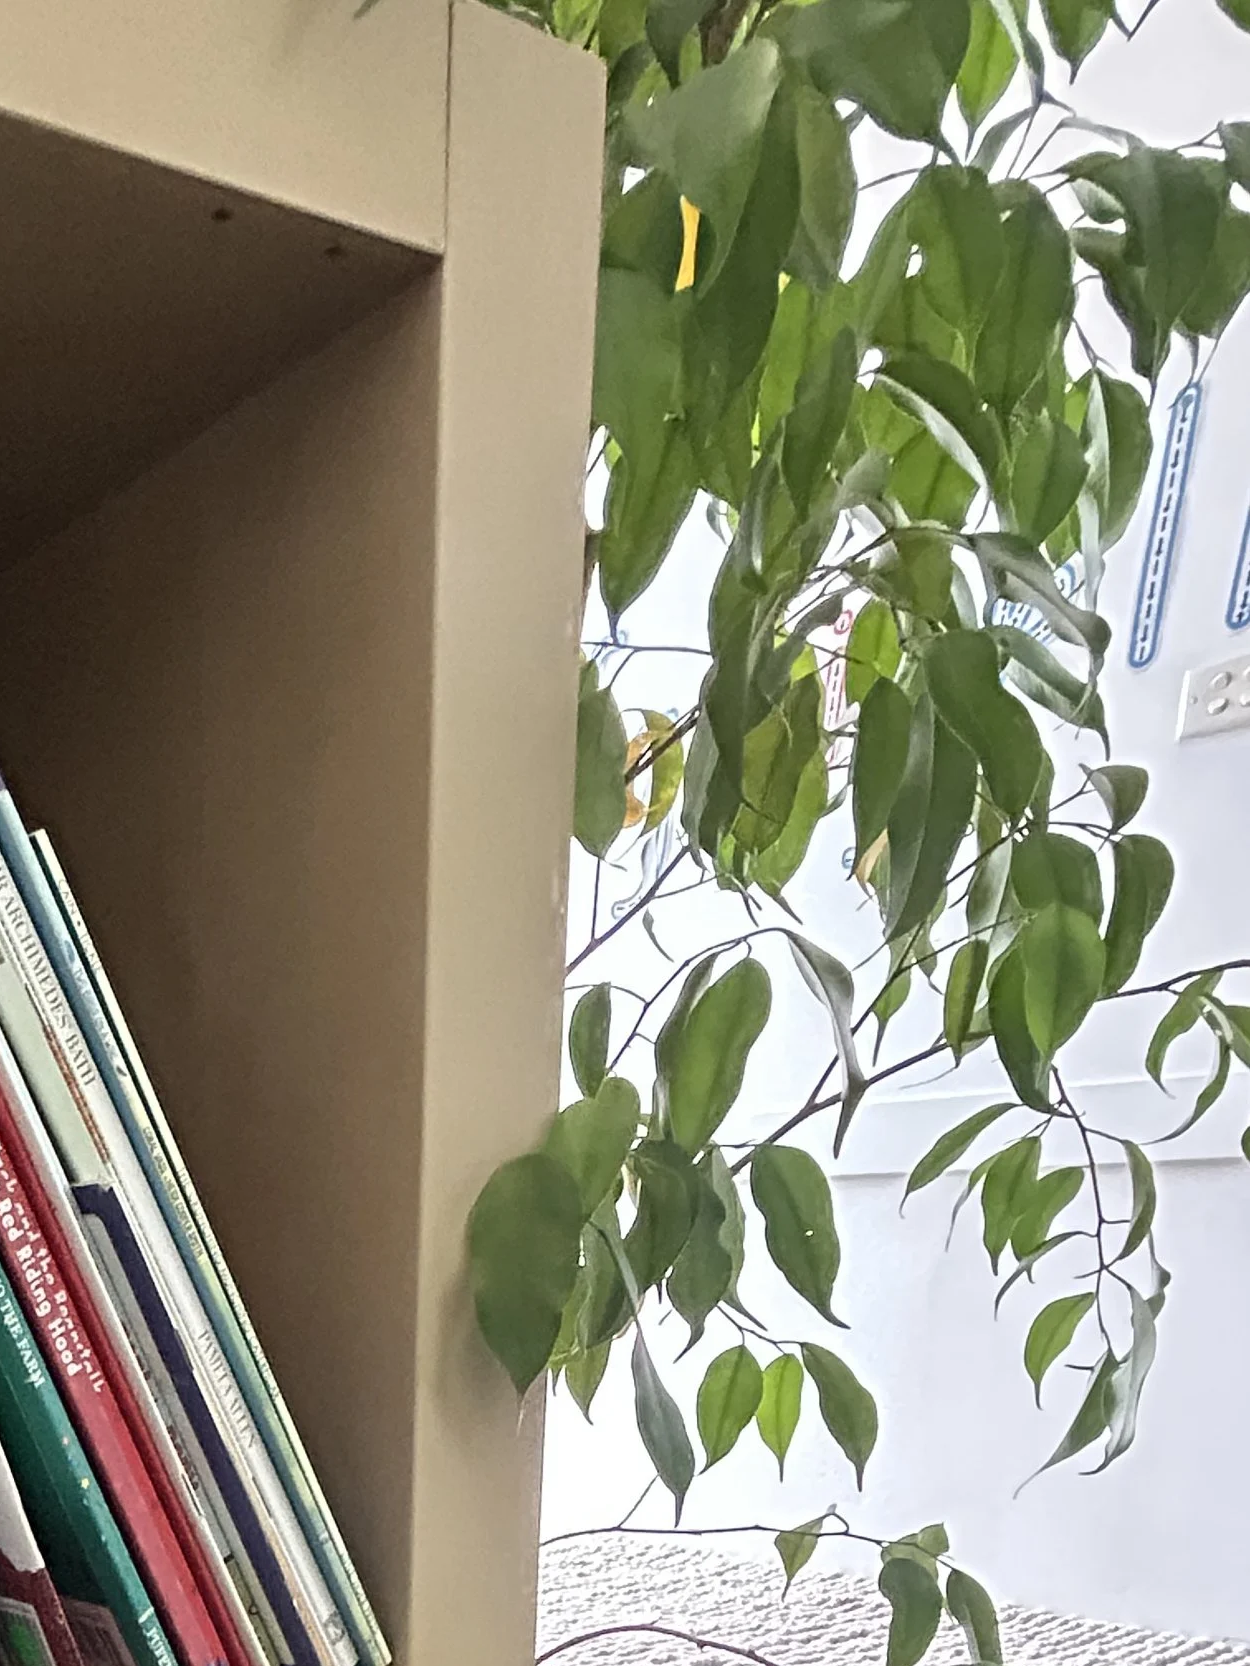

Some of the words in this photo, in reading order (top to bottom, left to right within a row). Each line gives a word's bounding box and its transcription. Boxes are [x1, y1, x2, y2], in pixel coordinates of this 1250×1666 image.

[64, 1033, 97, 1087] BATH
[14, 1243, 60, 1318] Riding
[46, 1317, 84, 1378] Hood
[14, 1337, 47, 1388] FARM
